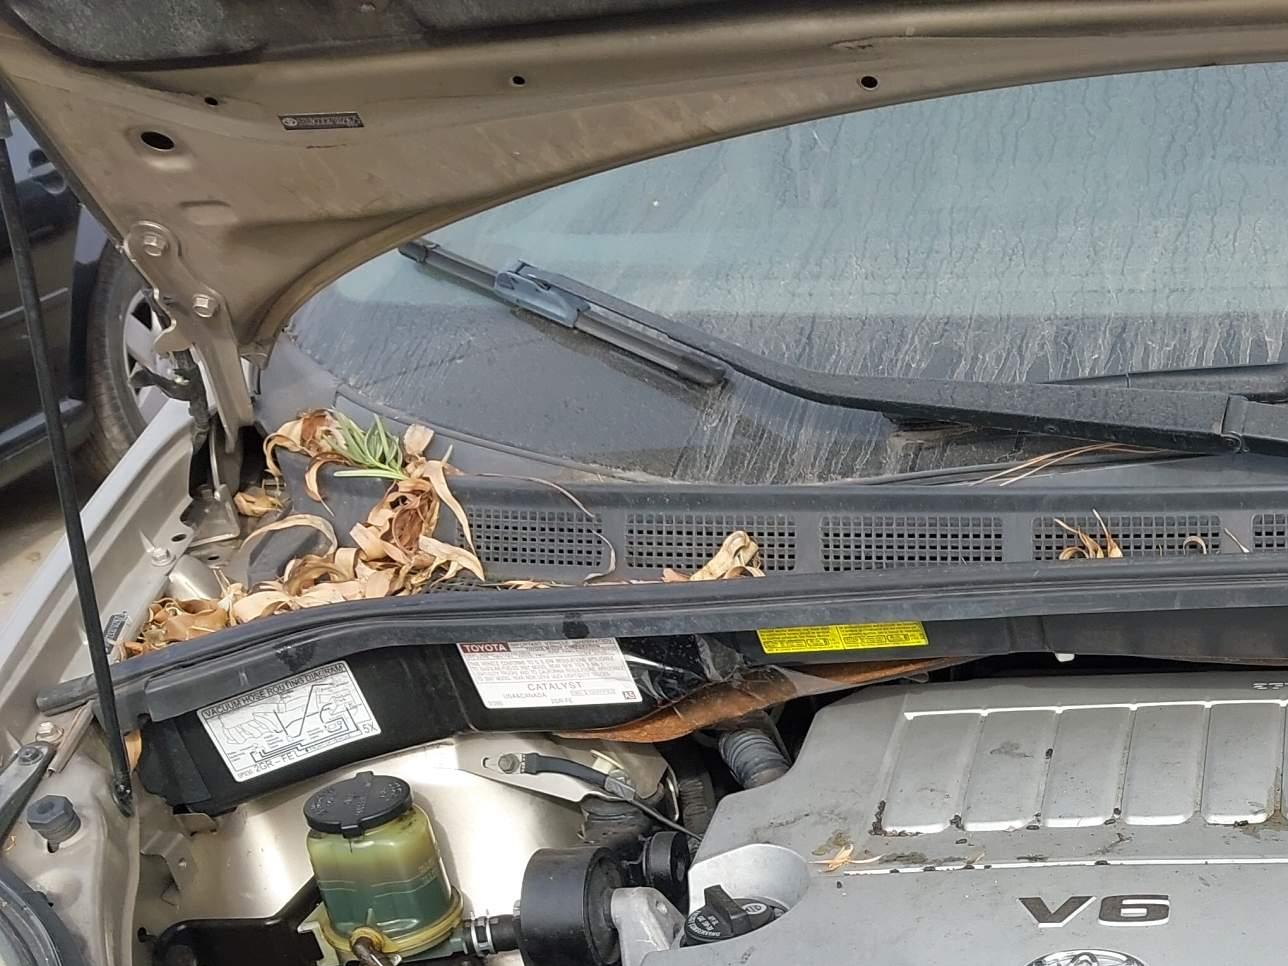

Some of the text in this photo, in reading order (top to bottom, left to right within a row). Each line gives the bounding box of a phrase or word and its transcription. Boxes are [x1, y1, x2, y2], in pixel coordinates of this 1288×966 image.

[463, 644, 506, 653] TOYOTA
[203, 664, 345, 719] VACUUM HOSE ROUTING DIAGRAM
[527, 682, 583, 691] CATALYST
[1016, 894, 1170, 927] V6
